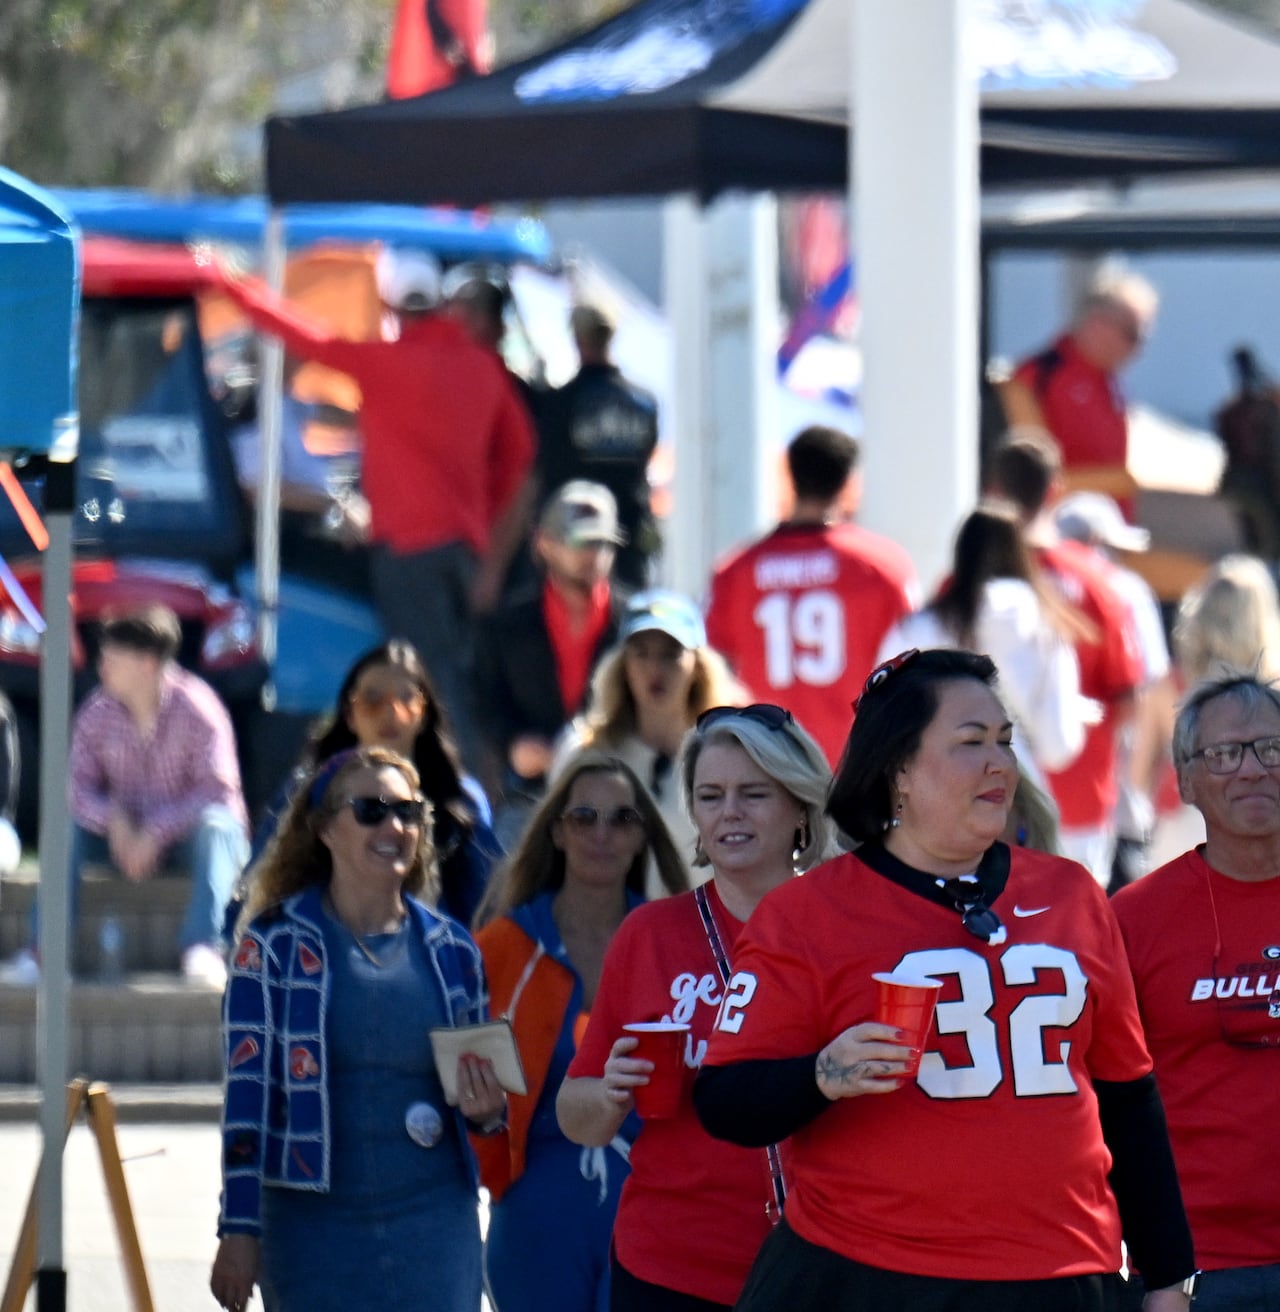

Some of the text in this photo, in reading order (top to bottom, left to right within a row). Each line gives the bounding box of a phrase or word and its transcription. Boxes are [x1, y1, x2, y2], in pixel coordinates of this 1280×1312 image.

[753, 590, 847, 689] 19
[714, 970, 758, 1035] 2
[891, 943, 1088, 1099] 32
